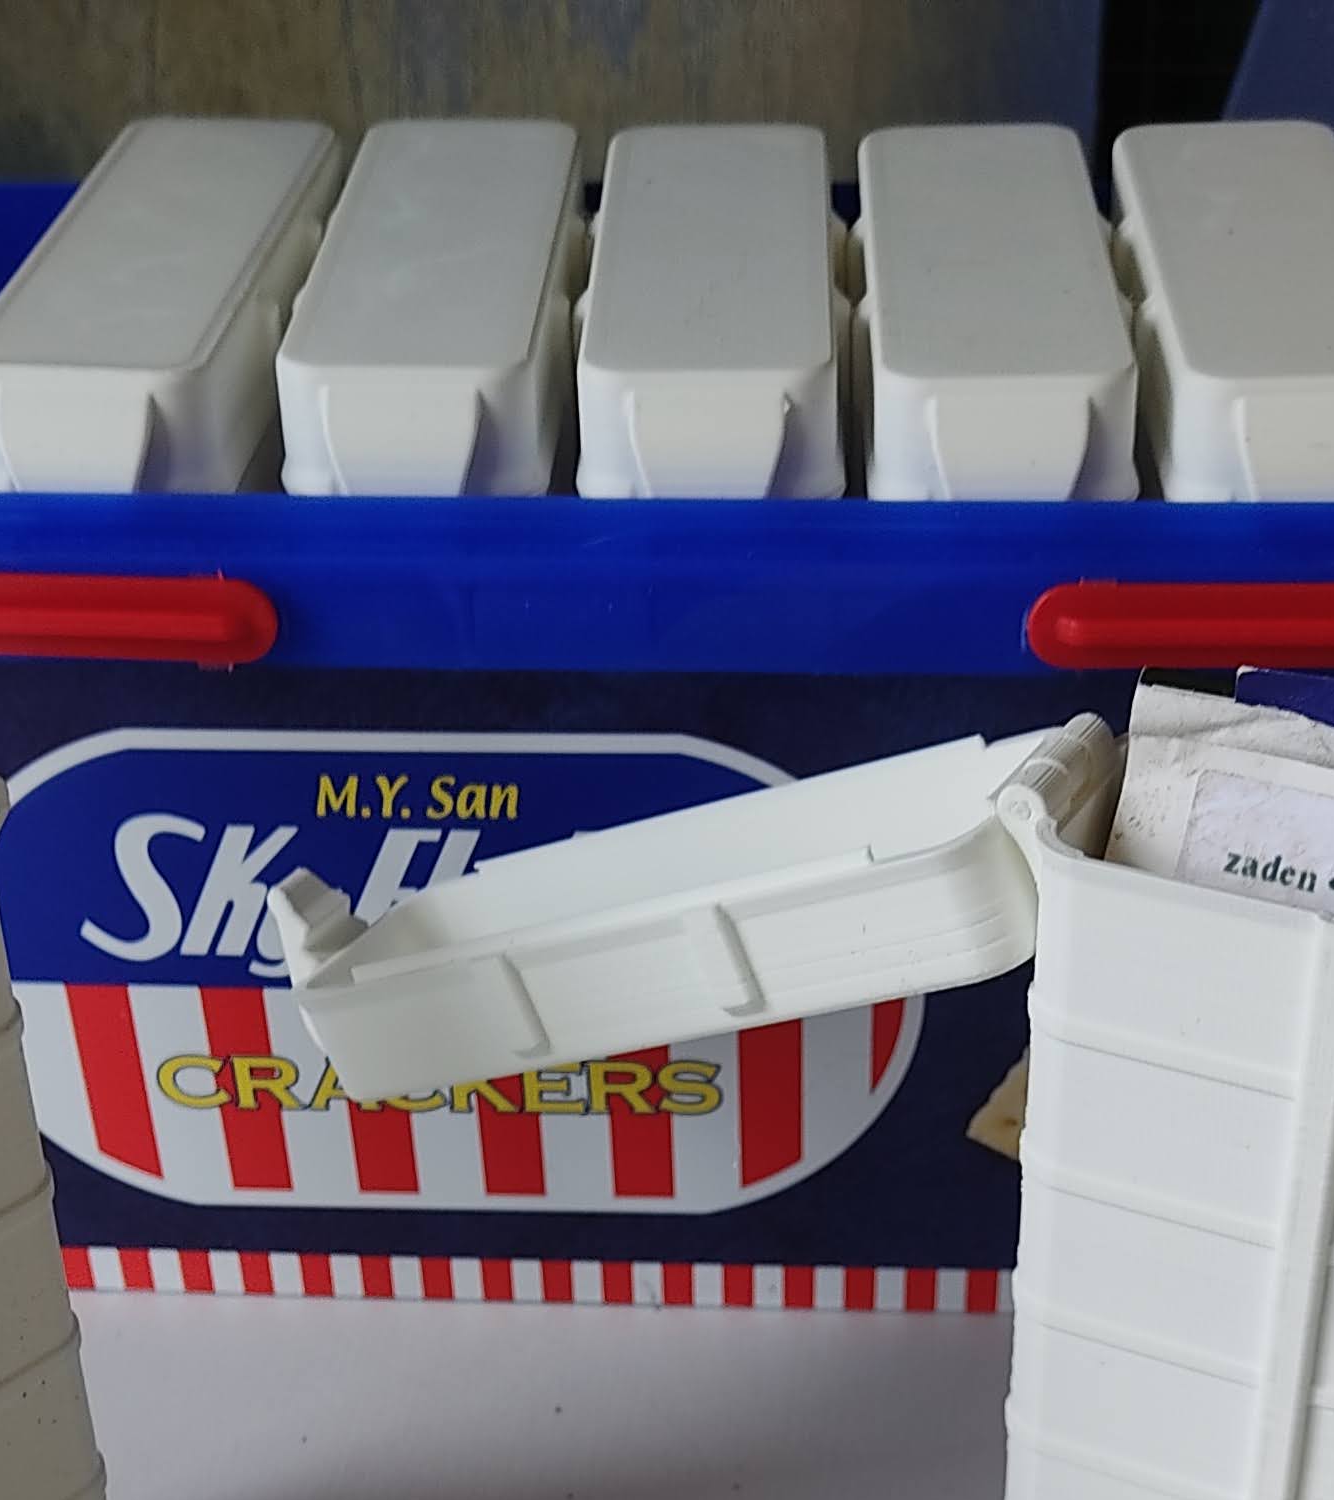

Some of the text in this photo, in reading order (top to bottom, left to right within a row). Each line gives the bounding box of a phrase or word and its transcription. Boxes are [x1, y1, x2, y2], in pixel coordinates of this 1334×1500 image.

[315, 775, 519, 819] M.Y. San
[1223, 851, 1317, 893] zaden
[156, 1053, 722, 1115] CRAKERS
